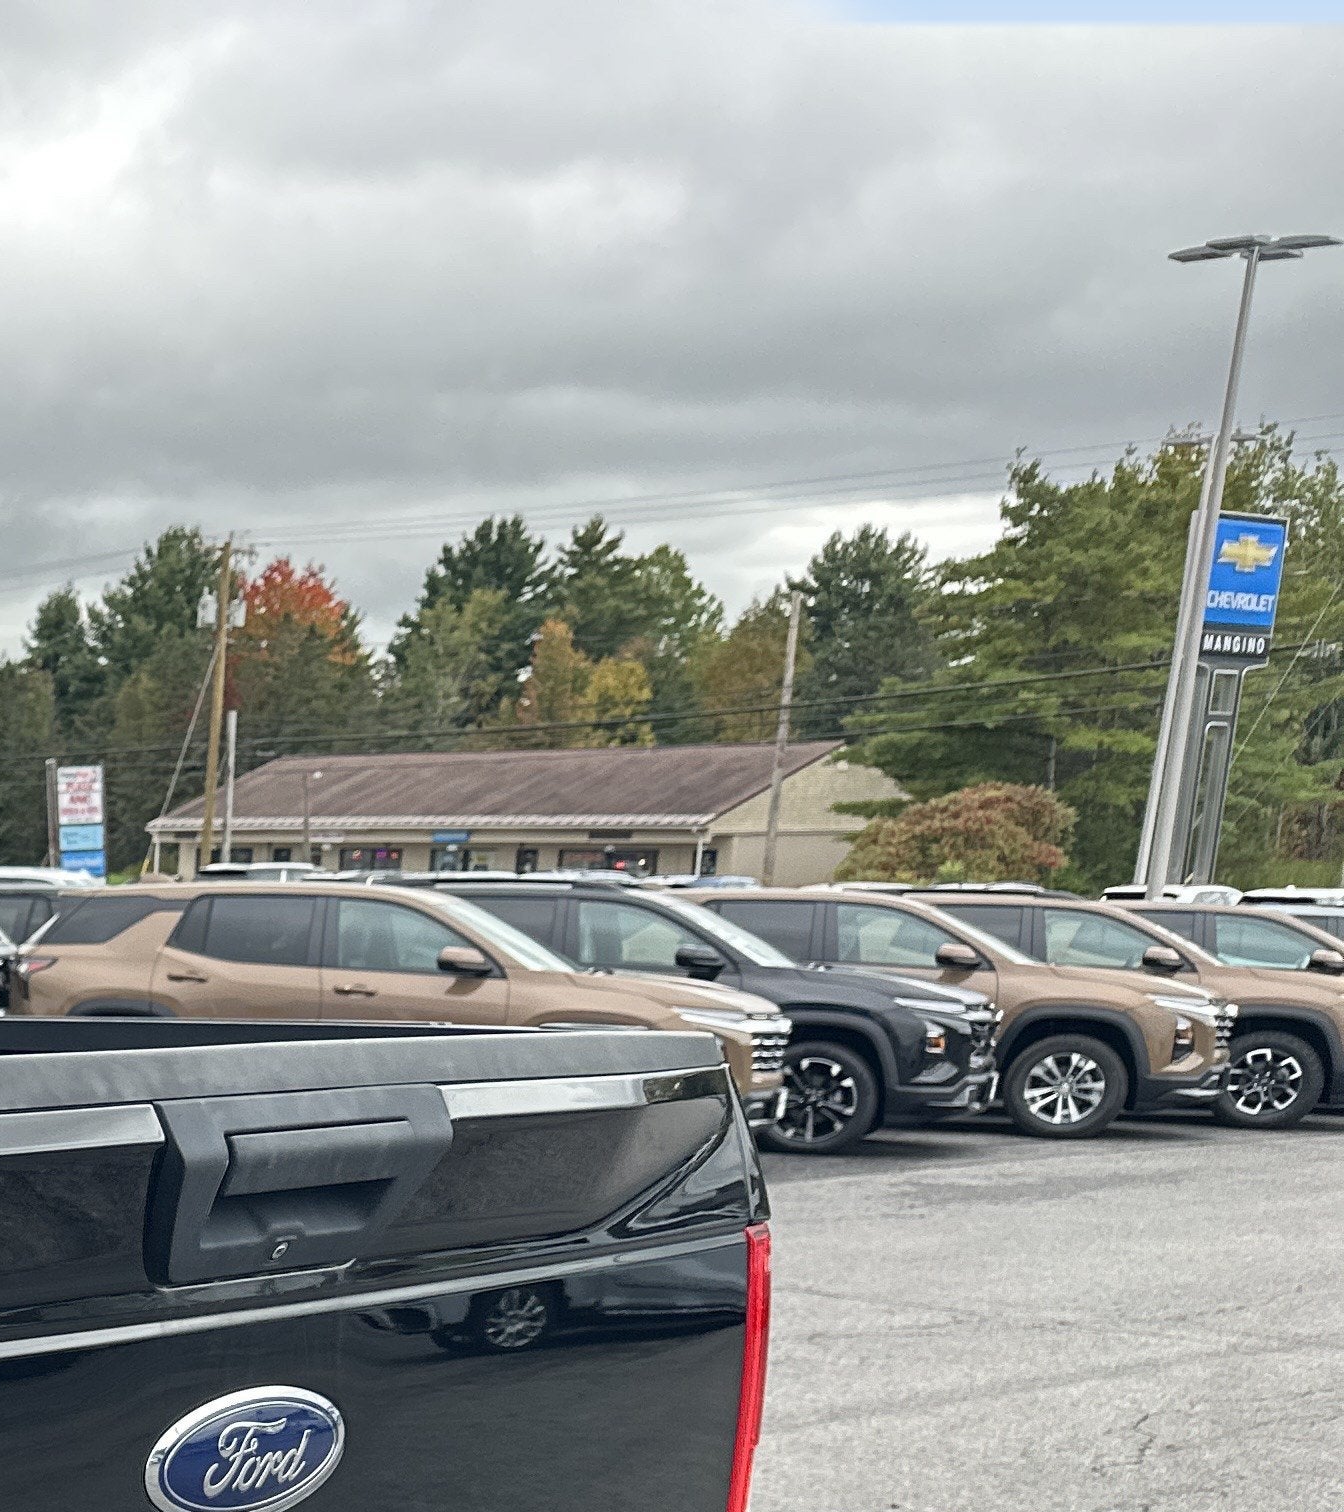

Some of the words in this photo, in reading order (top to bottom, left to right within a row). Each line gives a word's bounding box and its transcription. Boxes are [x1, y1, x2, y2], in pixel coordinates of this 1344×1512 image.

[1206, 589, 1276, 613] CHEVROLET
[1202, 633, 1266, 655] MANGINO
[202, 1417, 312, 1500] Ford
